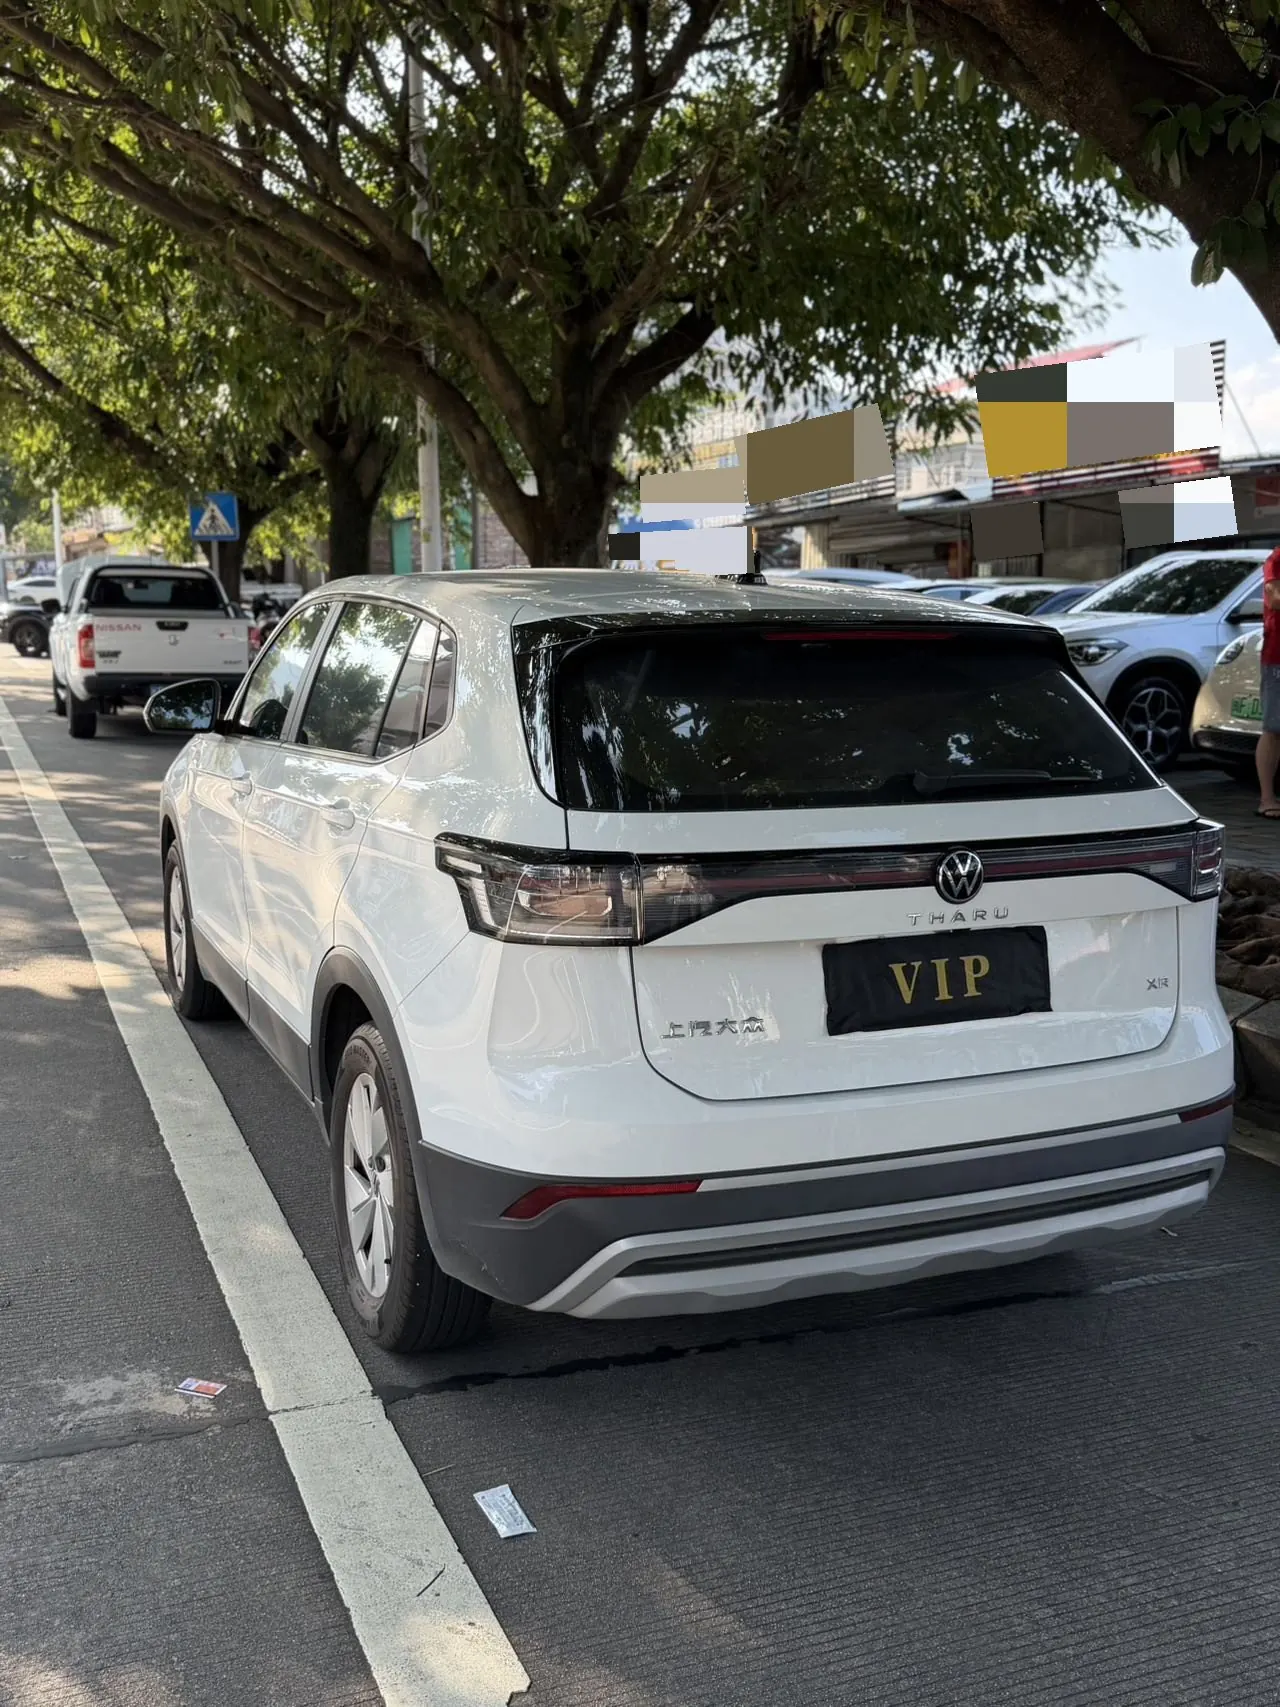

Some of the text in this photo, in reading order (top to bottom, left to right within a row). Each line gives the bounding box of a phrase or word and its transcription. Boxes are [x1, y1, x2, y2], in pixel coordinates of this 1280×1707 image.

[95, 623, 142, 633] NISSAN
[908, 907, 1008, 926] THARU
[888, 954, 990, 1004] VIP
[660, 1016, 764, 1039] 上汽大众
